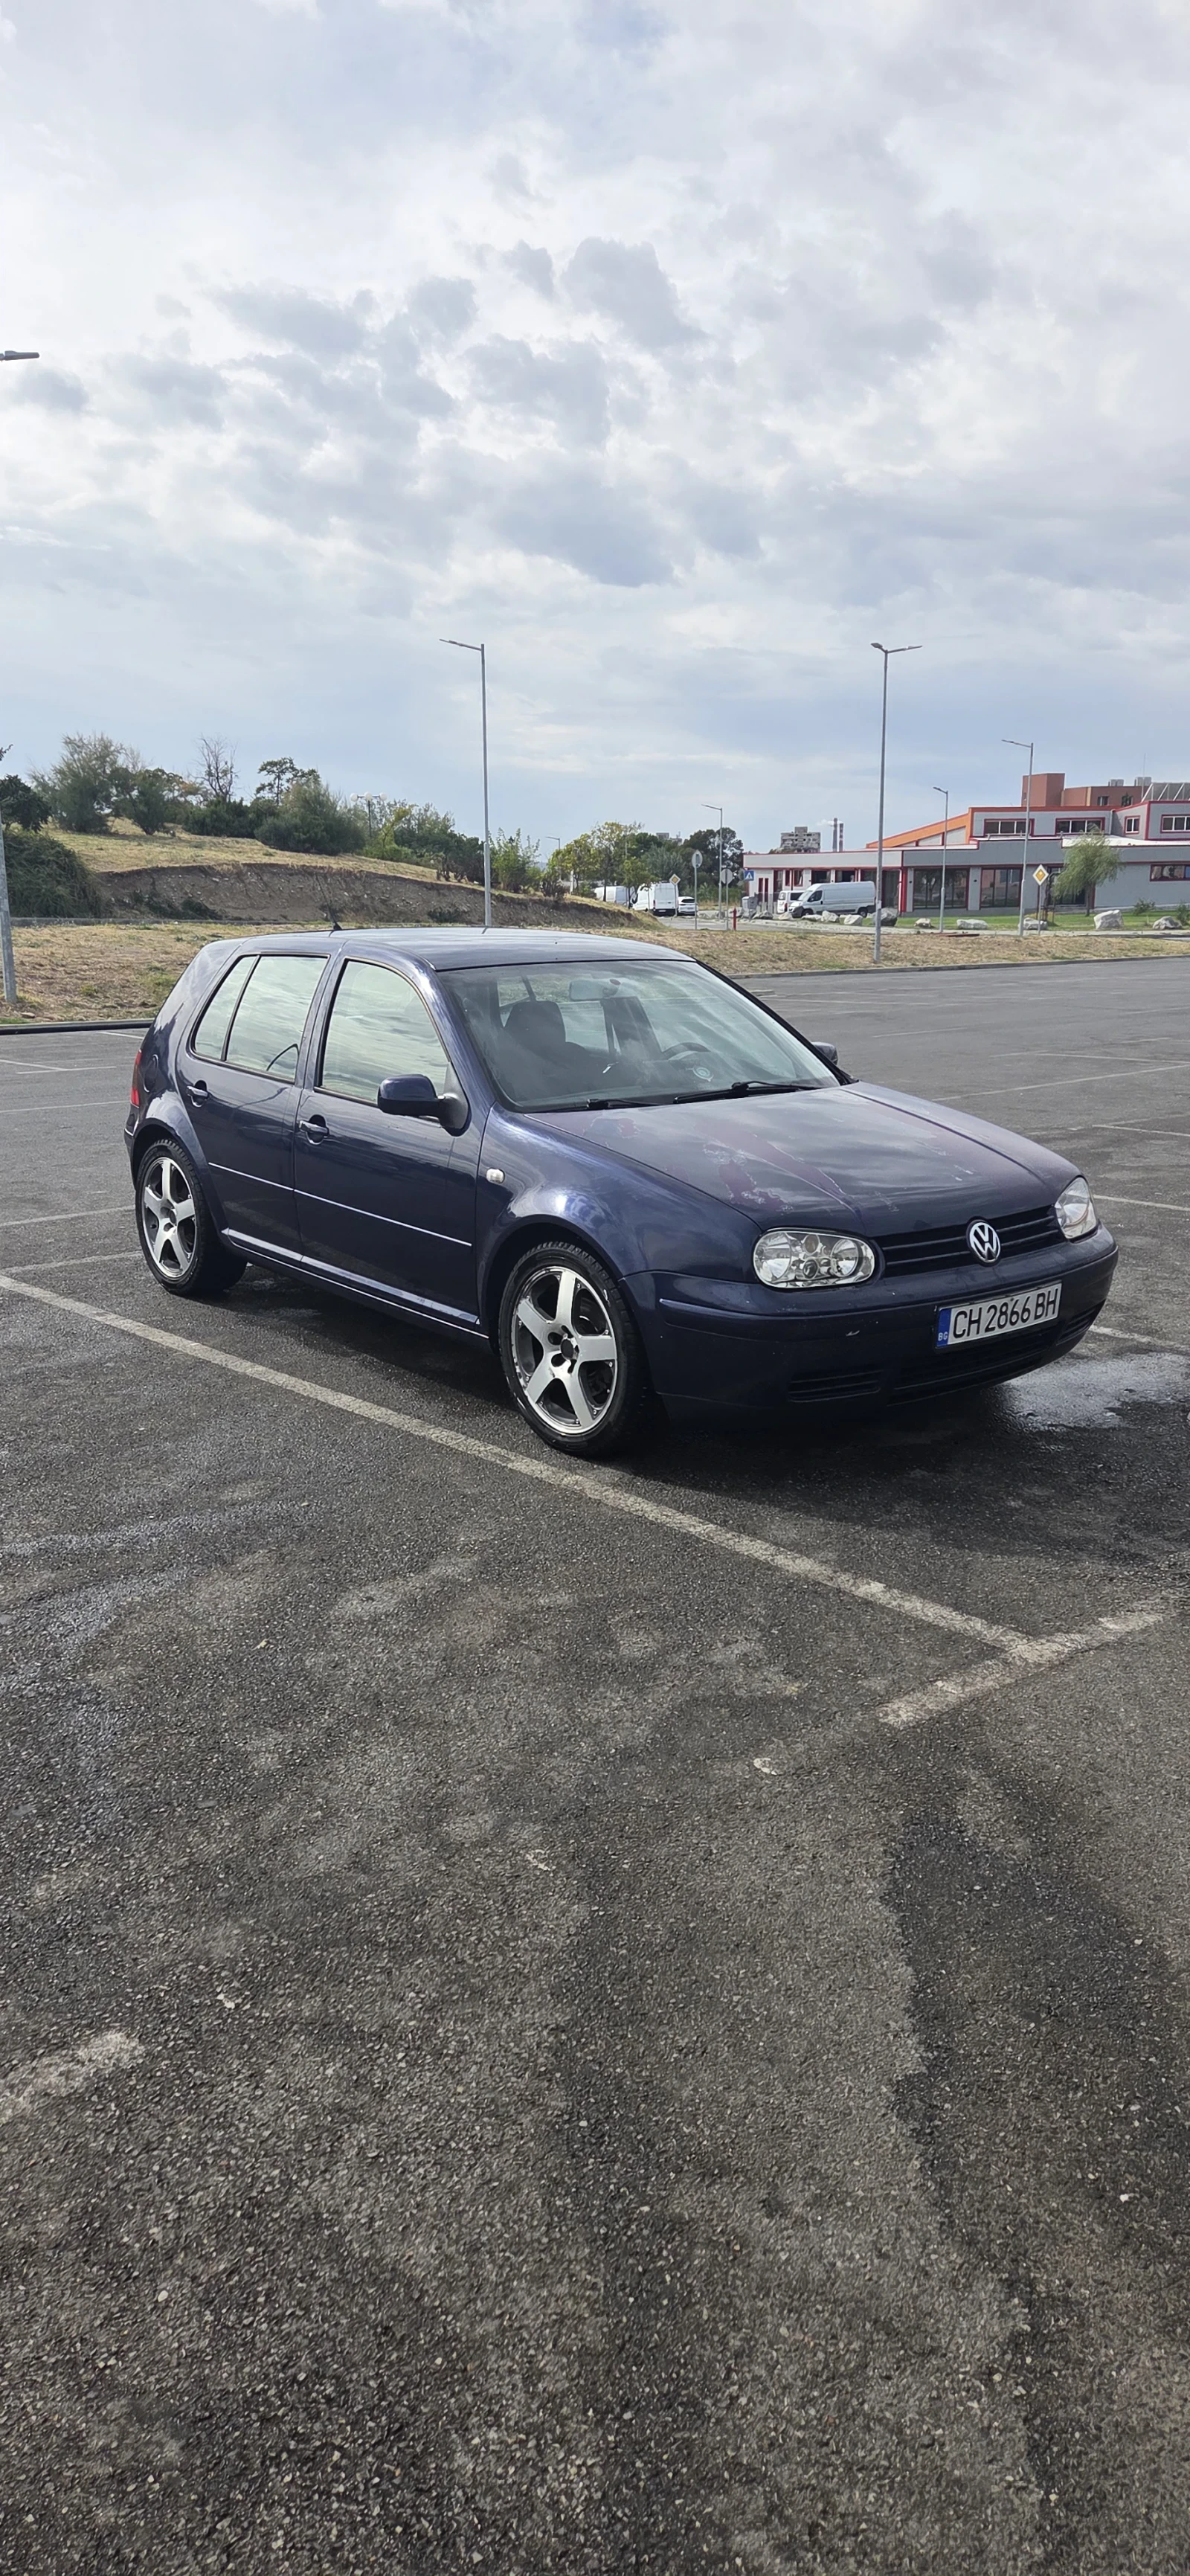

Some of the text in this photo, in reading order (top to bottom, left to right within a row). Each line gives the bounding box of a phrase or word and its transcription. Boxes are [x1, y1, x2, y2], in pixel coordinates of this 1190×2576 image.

[953, 1288, 1058, 1339] CH 2866 BH
[938, 1332, 948, 1341] BG
